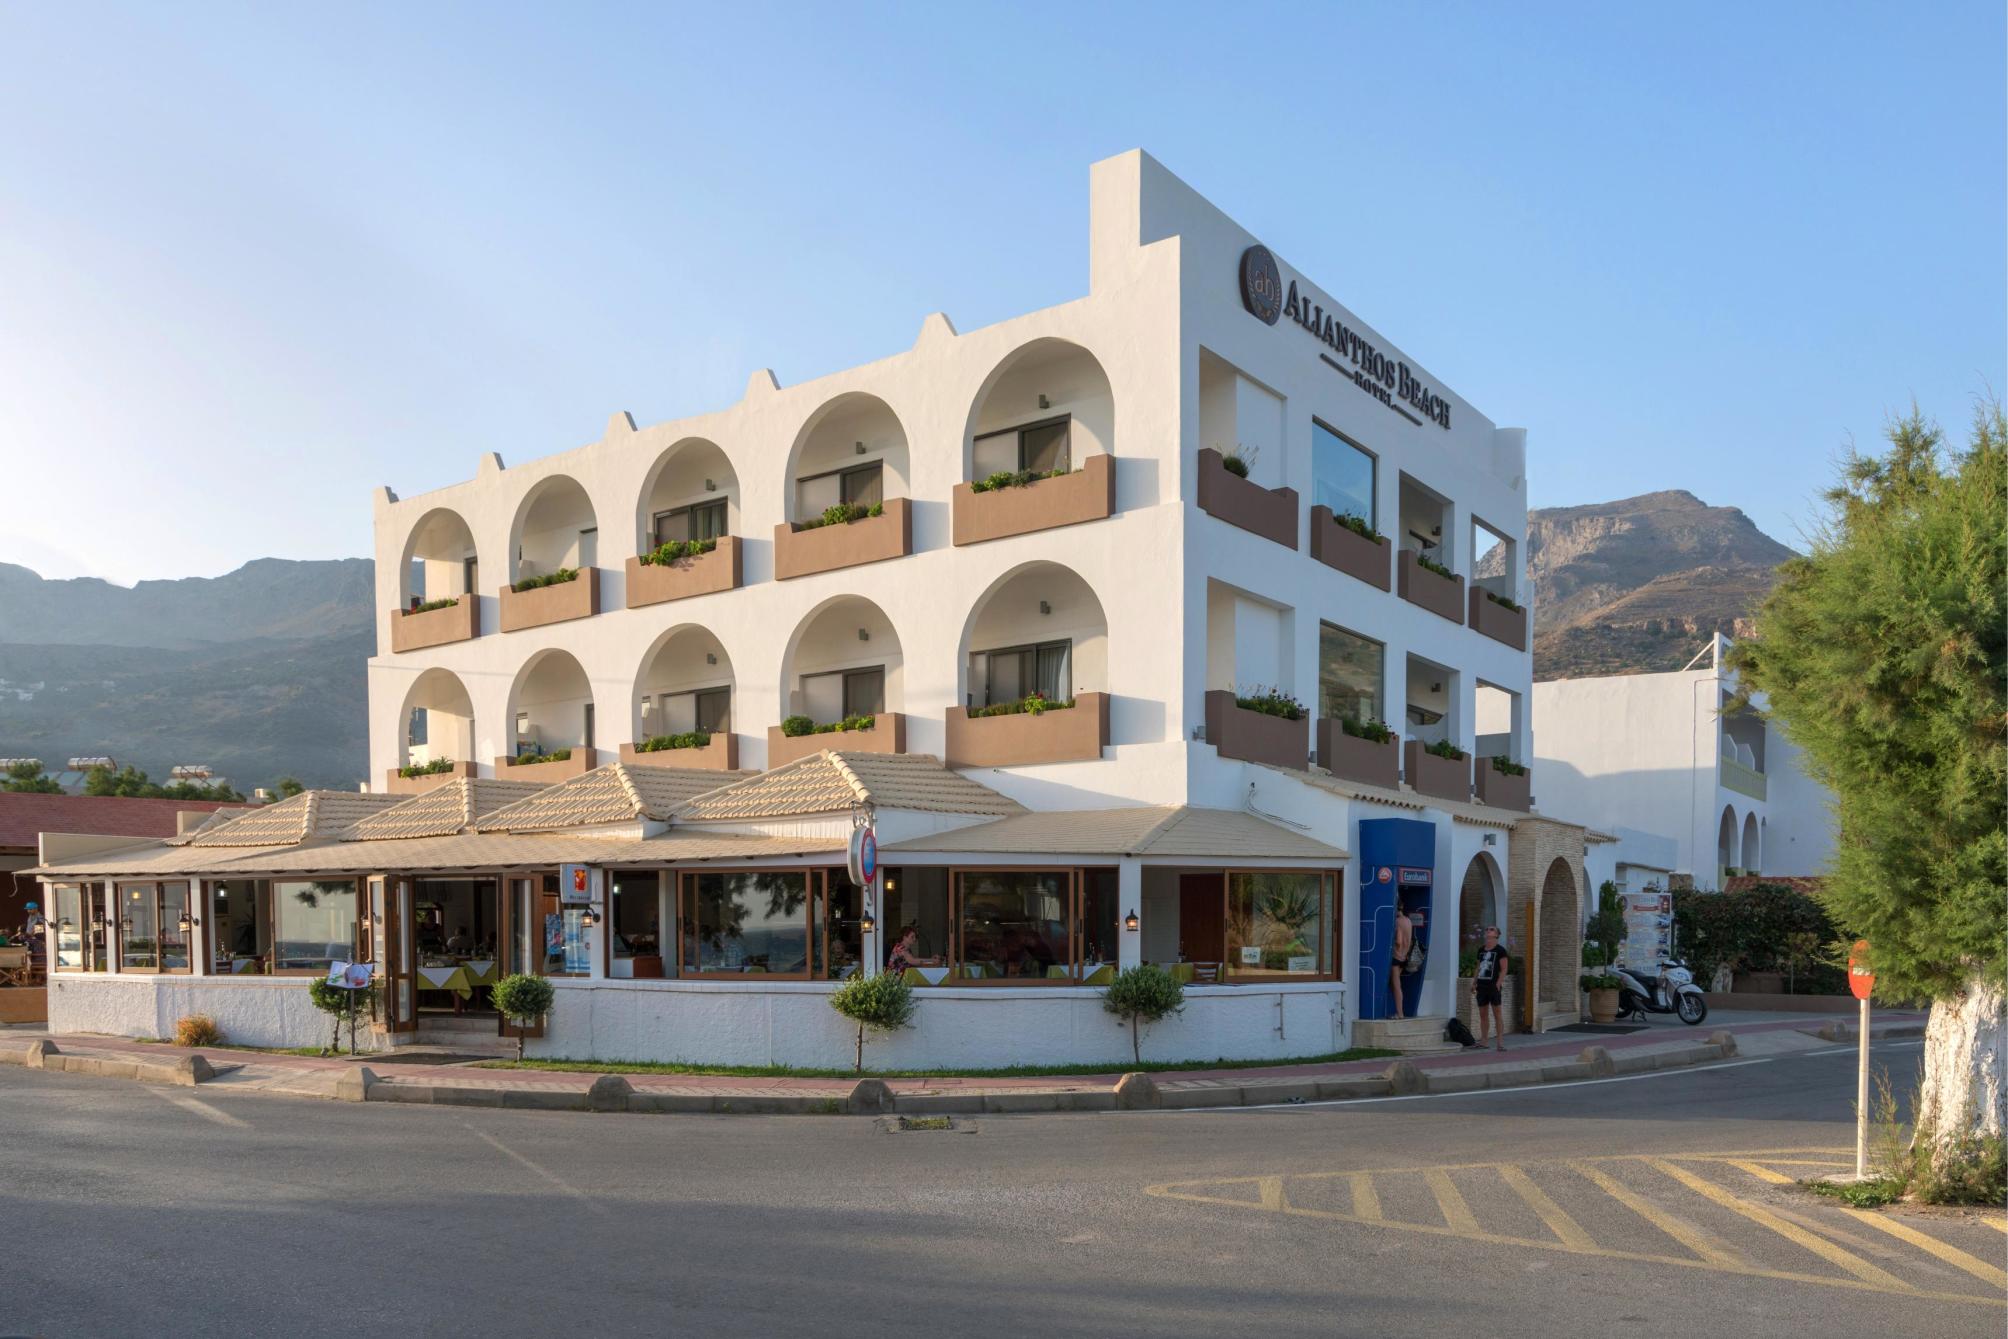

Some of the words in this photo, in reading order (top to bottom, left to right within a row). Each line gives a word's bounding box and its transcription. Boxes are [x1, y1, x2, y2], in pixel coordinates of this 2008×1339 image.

[1283, 279, 1396, 390] ALIANTHOS
[1397, 360, 1452, 431] BEACH
[1354, 370, 1395, 409] HOTEL
